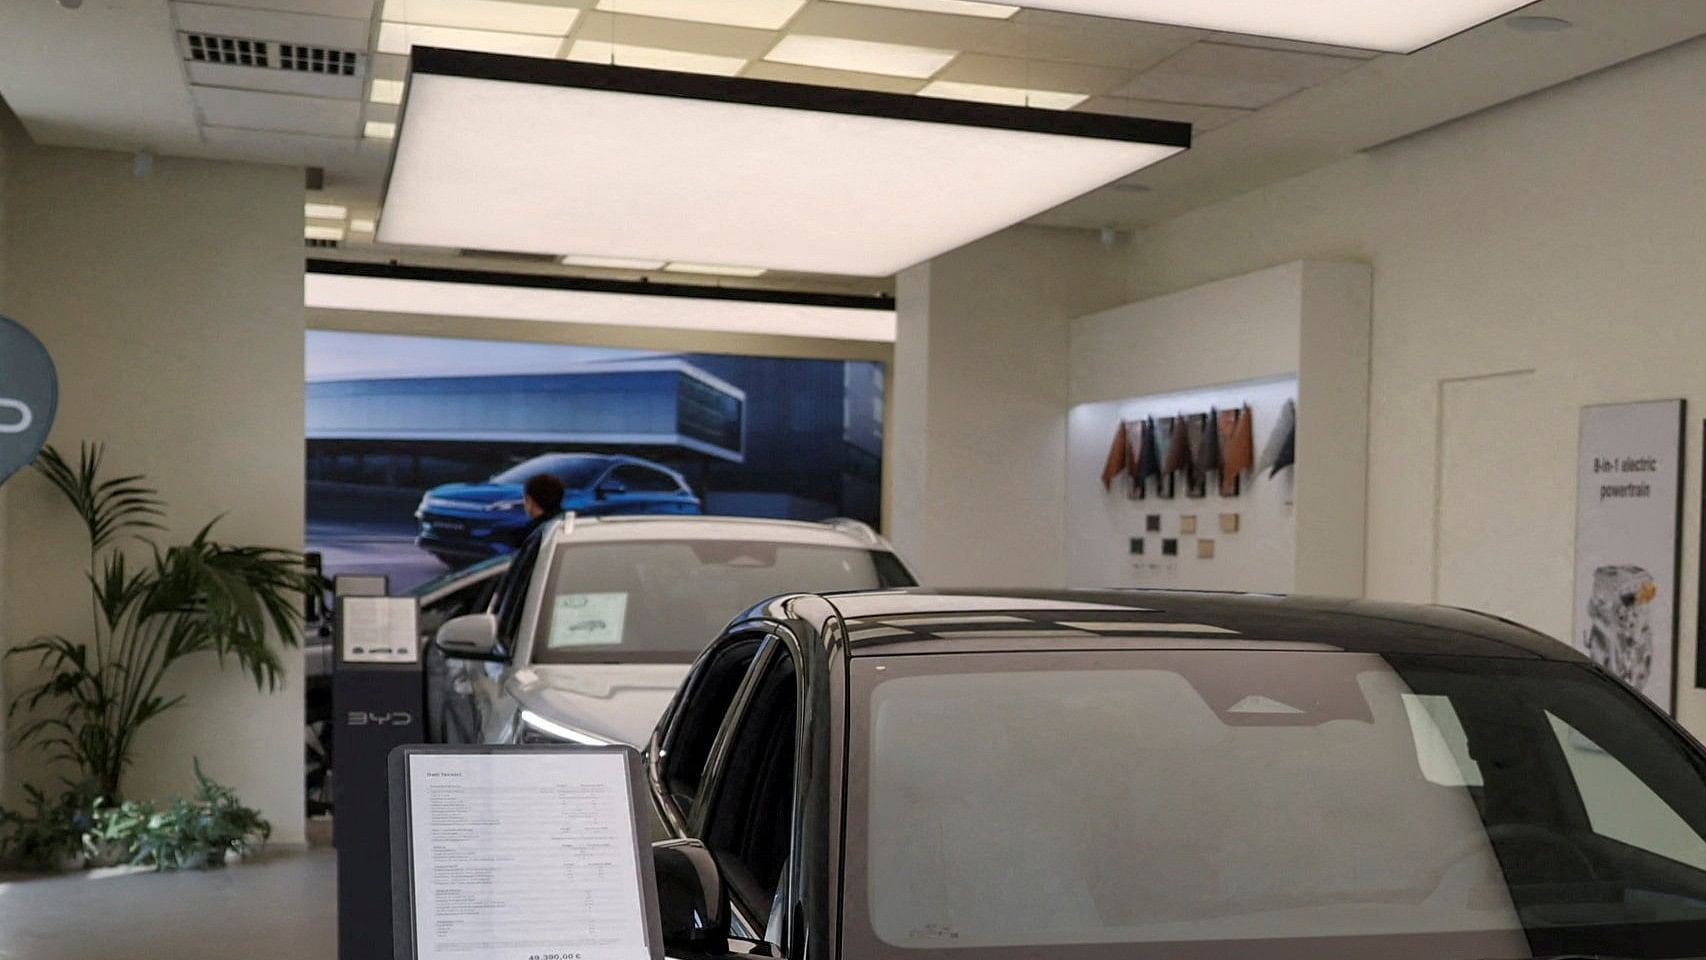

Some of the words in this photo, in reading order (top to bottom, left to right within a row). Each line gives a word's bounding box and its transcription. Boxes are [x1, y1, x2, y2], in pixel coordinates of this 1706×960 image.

[1593, 457, 1619, 474] 8-in-1
[1621, 456, 1656, 472] electric
[1600, 482, 1650, 501] powertrain
[347, 710, 412, 726] BYD
